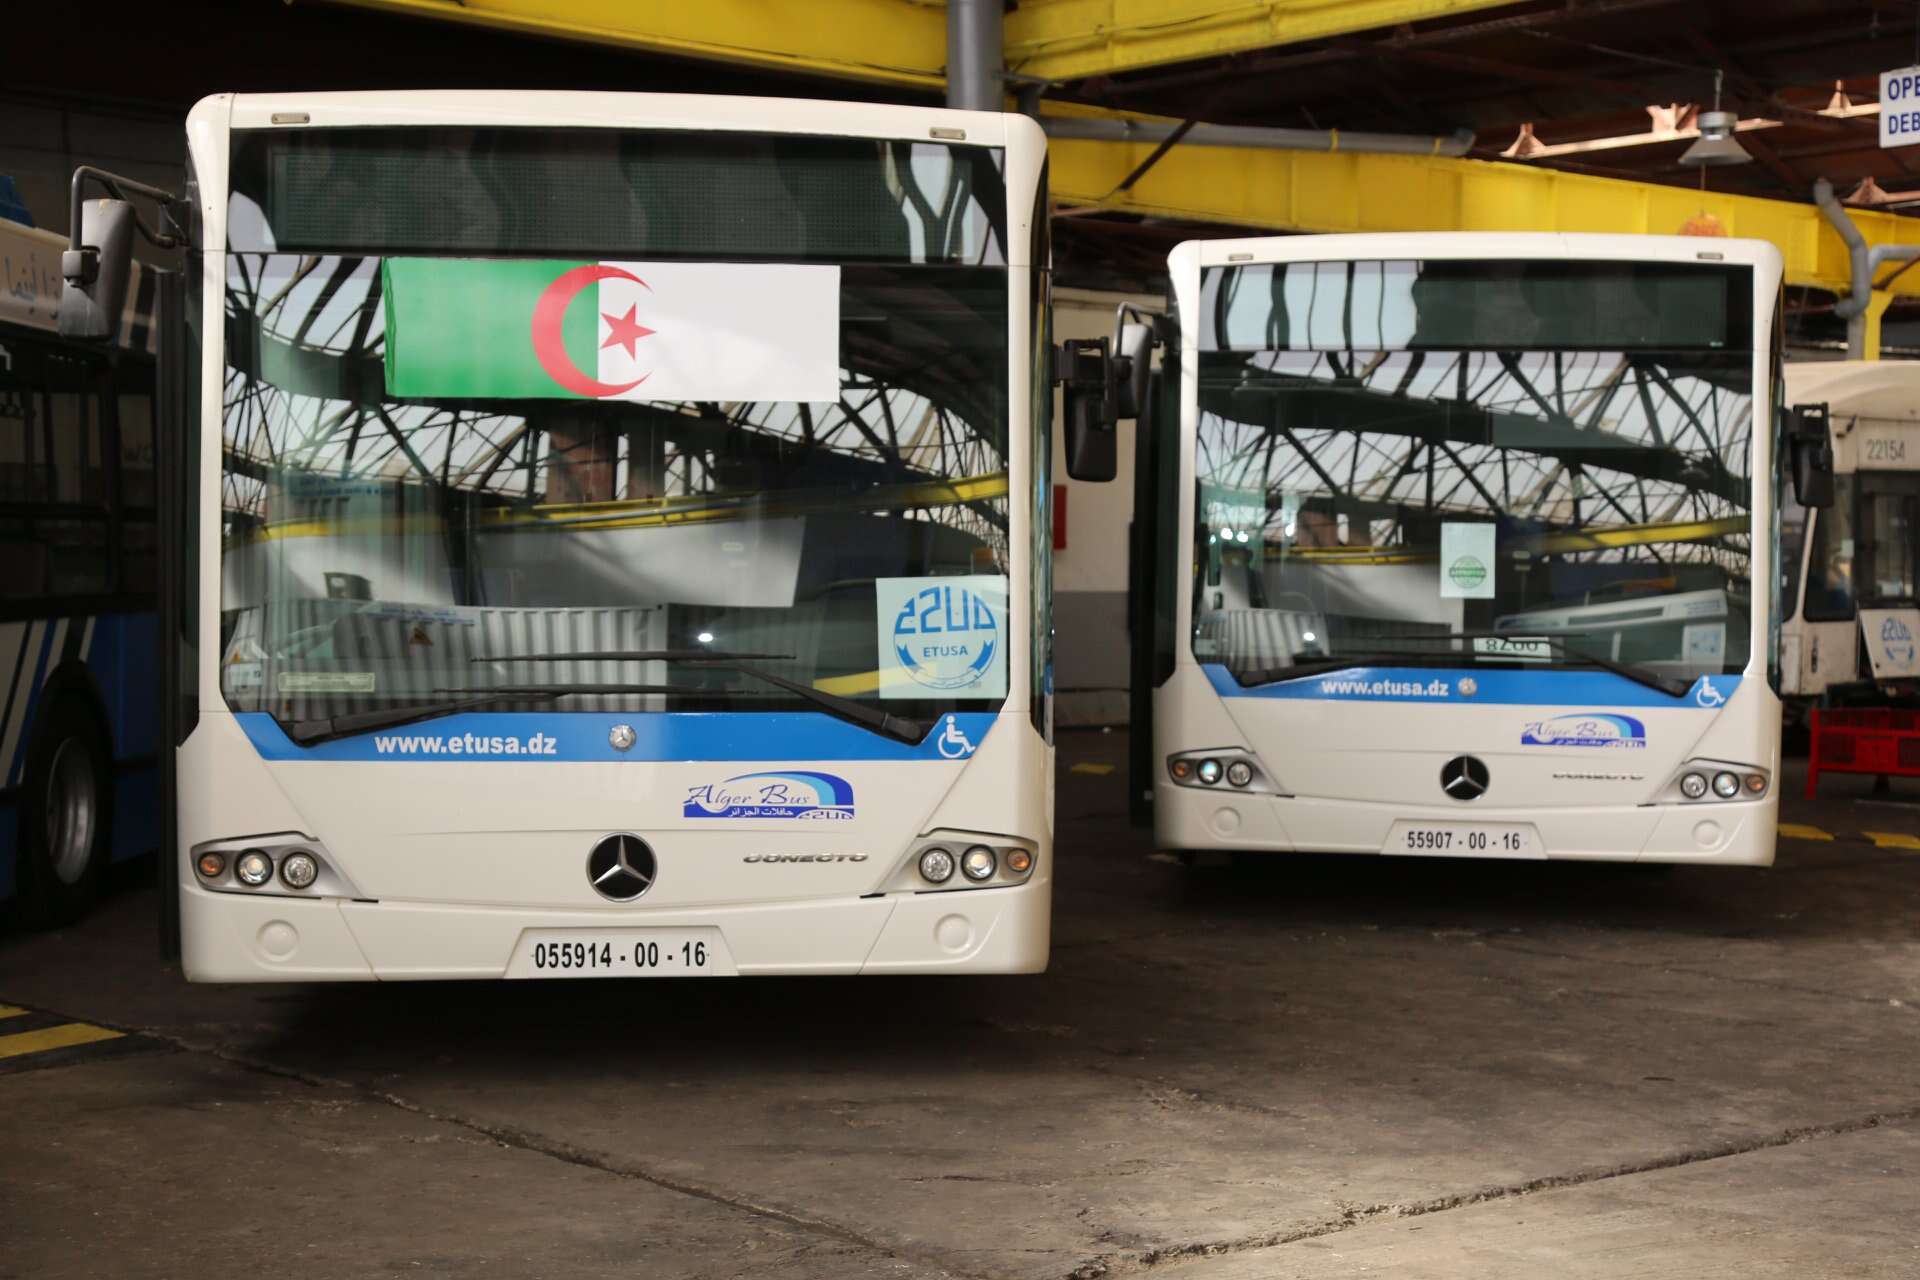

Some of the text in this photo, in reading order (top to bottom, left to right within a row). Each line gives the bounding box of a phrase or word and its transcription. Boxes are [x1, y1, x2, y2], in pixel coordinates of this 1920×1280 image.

[1889, 111, 1920, 135] DEB
[1866, 439, 1905, 461] 22154
[923, 645, 968, 658] ETUSA
[1321, 678, 1449, 696] www.etusa.dz
[374, 732, 557, 755] www.etusa.dz
[683, 784, 810, 809] Alger Bus
[743, 853, 869, 864] CONECTO
